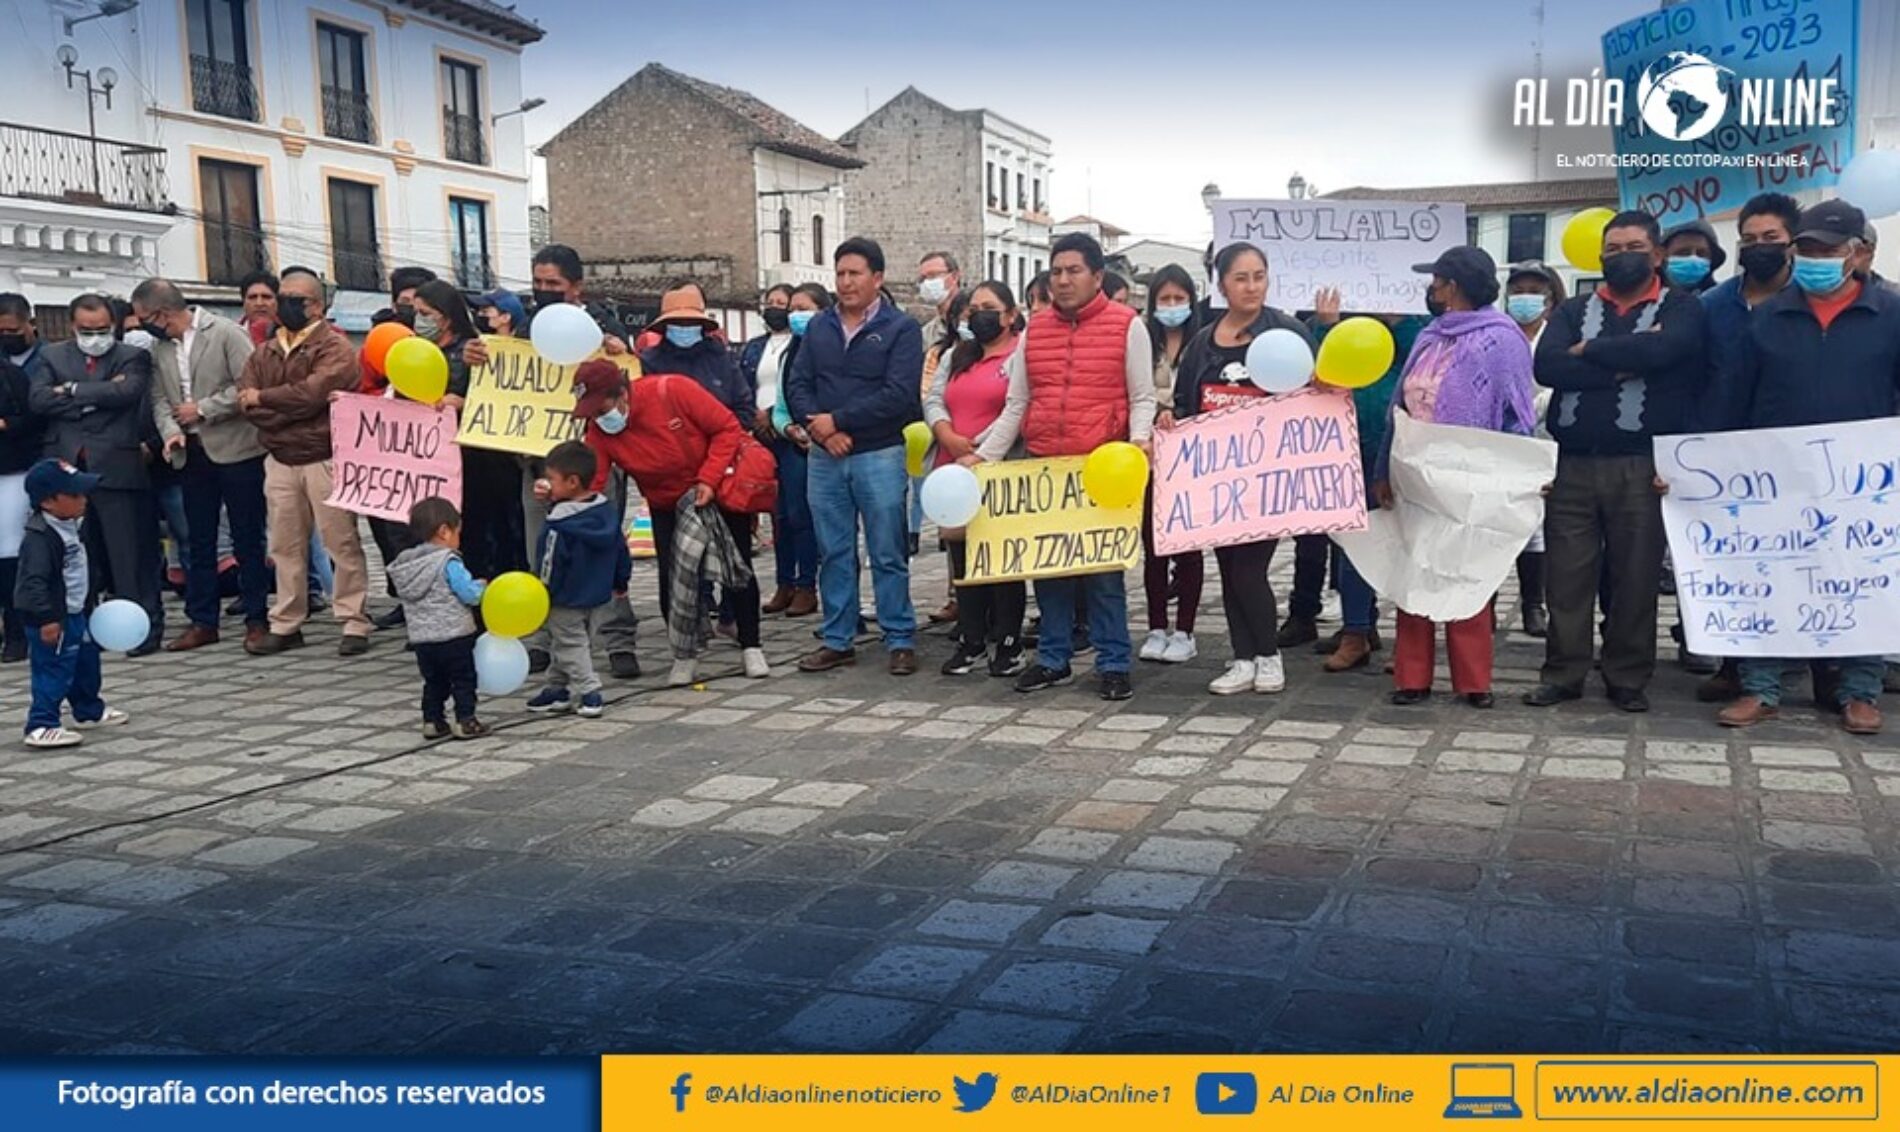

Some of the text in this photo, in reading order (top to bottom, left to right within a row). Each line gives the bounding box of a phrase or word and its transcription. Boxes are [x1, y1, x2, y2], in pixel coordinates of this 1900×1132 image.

[1229, 204, 1440, 242] MULALÓ
[355, 410, 442, 459] MULALÓ
[466, 403, 498, 435] AL
[504, 404, 534, 436] DR
[1166, 415, 1344, 482] MULALÓ APOYA
[1674, 437, 1900, 500] San Jua
[1166, 463, 1356, 533] AL DR TINAJERO
[1033, 526, 1139, 570] TINAJERO
[1704, 602, 1857, 634] Alcalde 2023
